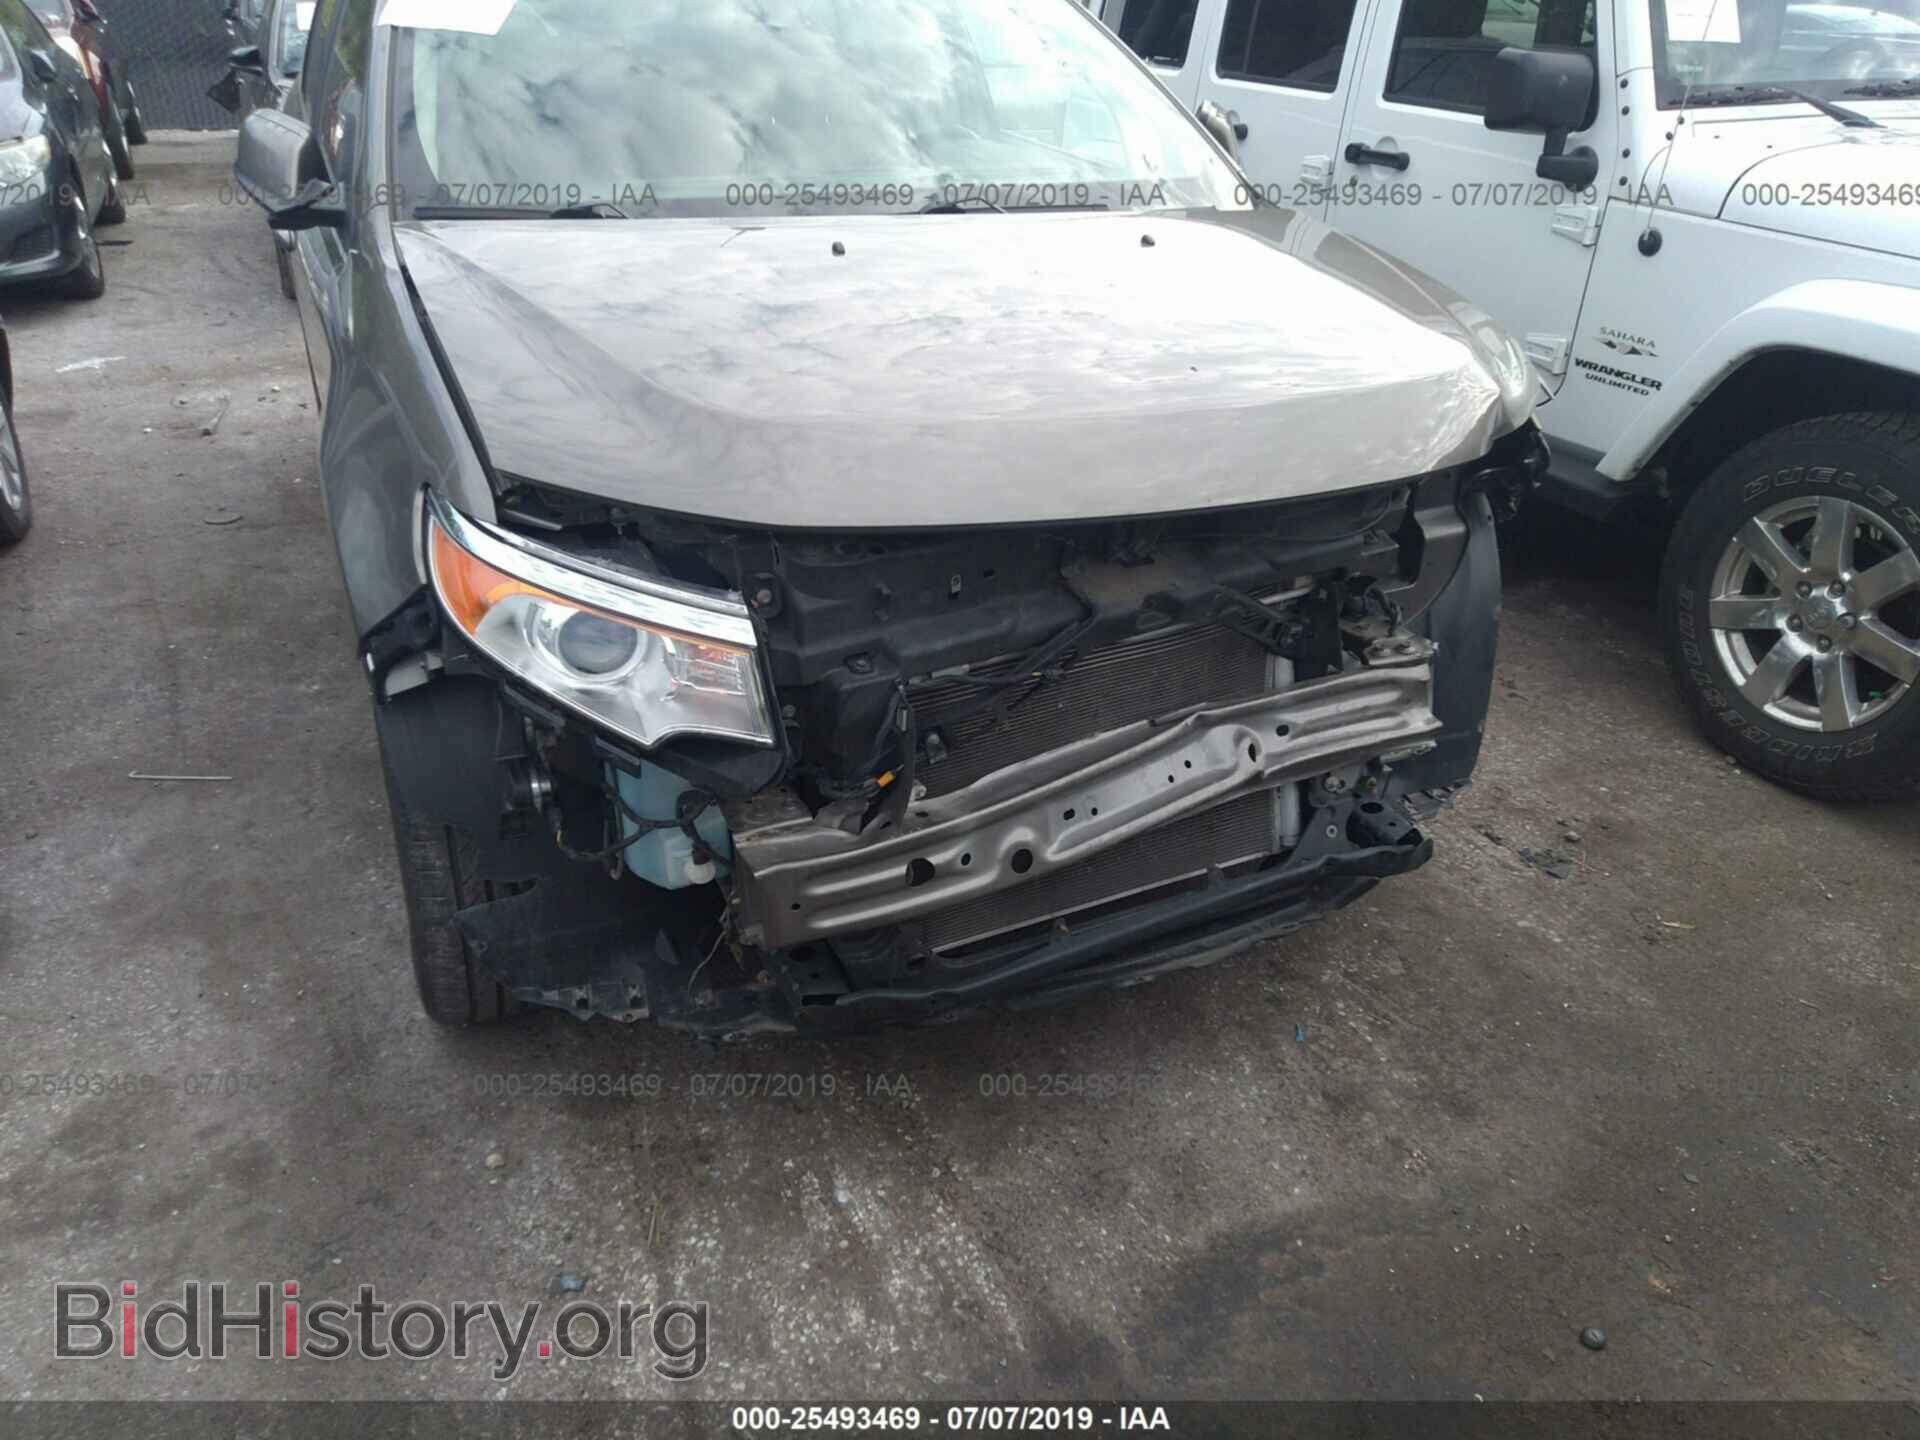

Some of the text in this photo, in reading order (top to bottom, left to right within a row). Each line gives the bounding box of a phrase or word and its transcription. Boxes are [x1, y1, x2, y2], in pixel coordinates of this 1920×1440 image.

[1600, 326, 1656, 348] SAHARA
[1574, 358, 1663, 391] WRANGLER
[1585, 373, 1650, 396] UNLIMITED
